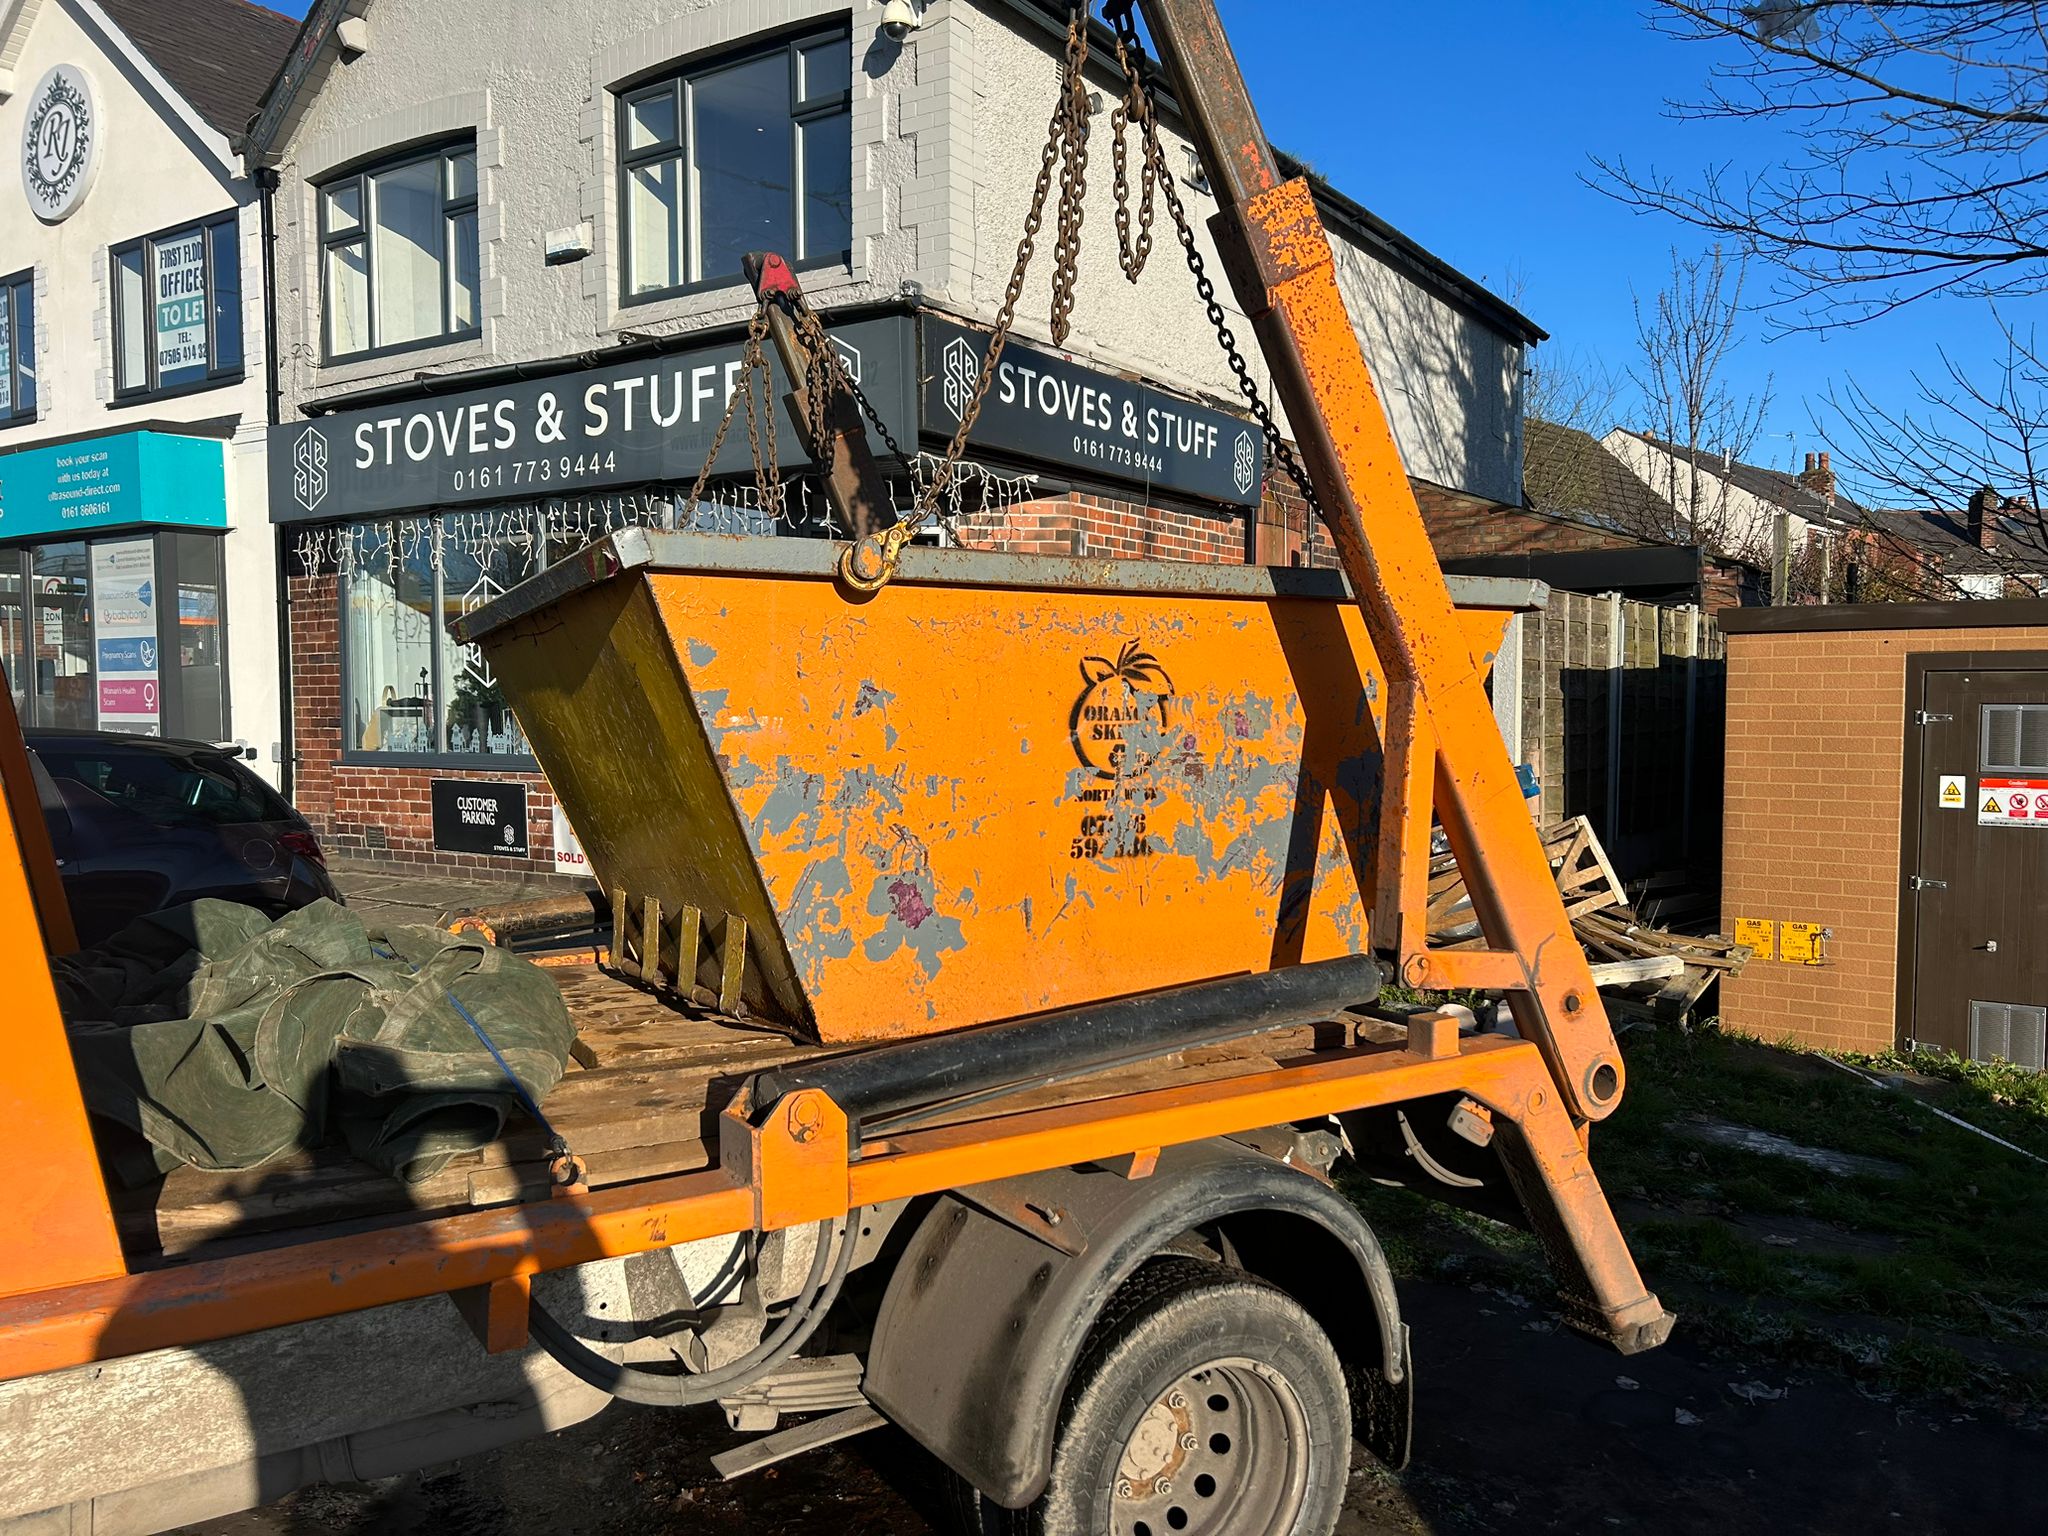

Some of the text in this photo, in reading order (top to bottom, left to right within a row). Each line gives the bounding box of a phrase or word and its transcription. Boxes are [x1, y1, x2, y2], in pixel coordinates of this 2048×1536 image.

[160, 241, 203, 269] FIRST FLOO
[161, 266, 205, 298] OFFICES
[162, 299, 205, 327] TO LET
[178, 331, 191, 344] TEL:
[198, 342, 207, 358] 32
[354, 399, 516, 470] STOVES
[534, 391, 567, 444] &
[583, 361, 747, 437] STUFF
[999, 361, 1218, 459] STOVES & STUFF
[57, 452, 108, 468] book your scan
[1073, 435, 1163, 473] 0161 773 9444
[58, 467, 109, 483] with us today at
[454, 450, 616, 491] 0161 773 9444
[48, 484, 120, 501] ultrasound-direct.com
[62, 506, 78, 518] 0161
[45, 612, 61, 621] ZON
[102, 651, 124, 660] Pregnancy
[123, 686, 137, 695] Health
[457, 796, 498, 813] CUSTOMER
[461, 811, 496, 826] PARKING
[557, 851, 584, 864] SOLD
